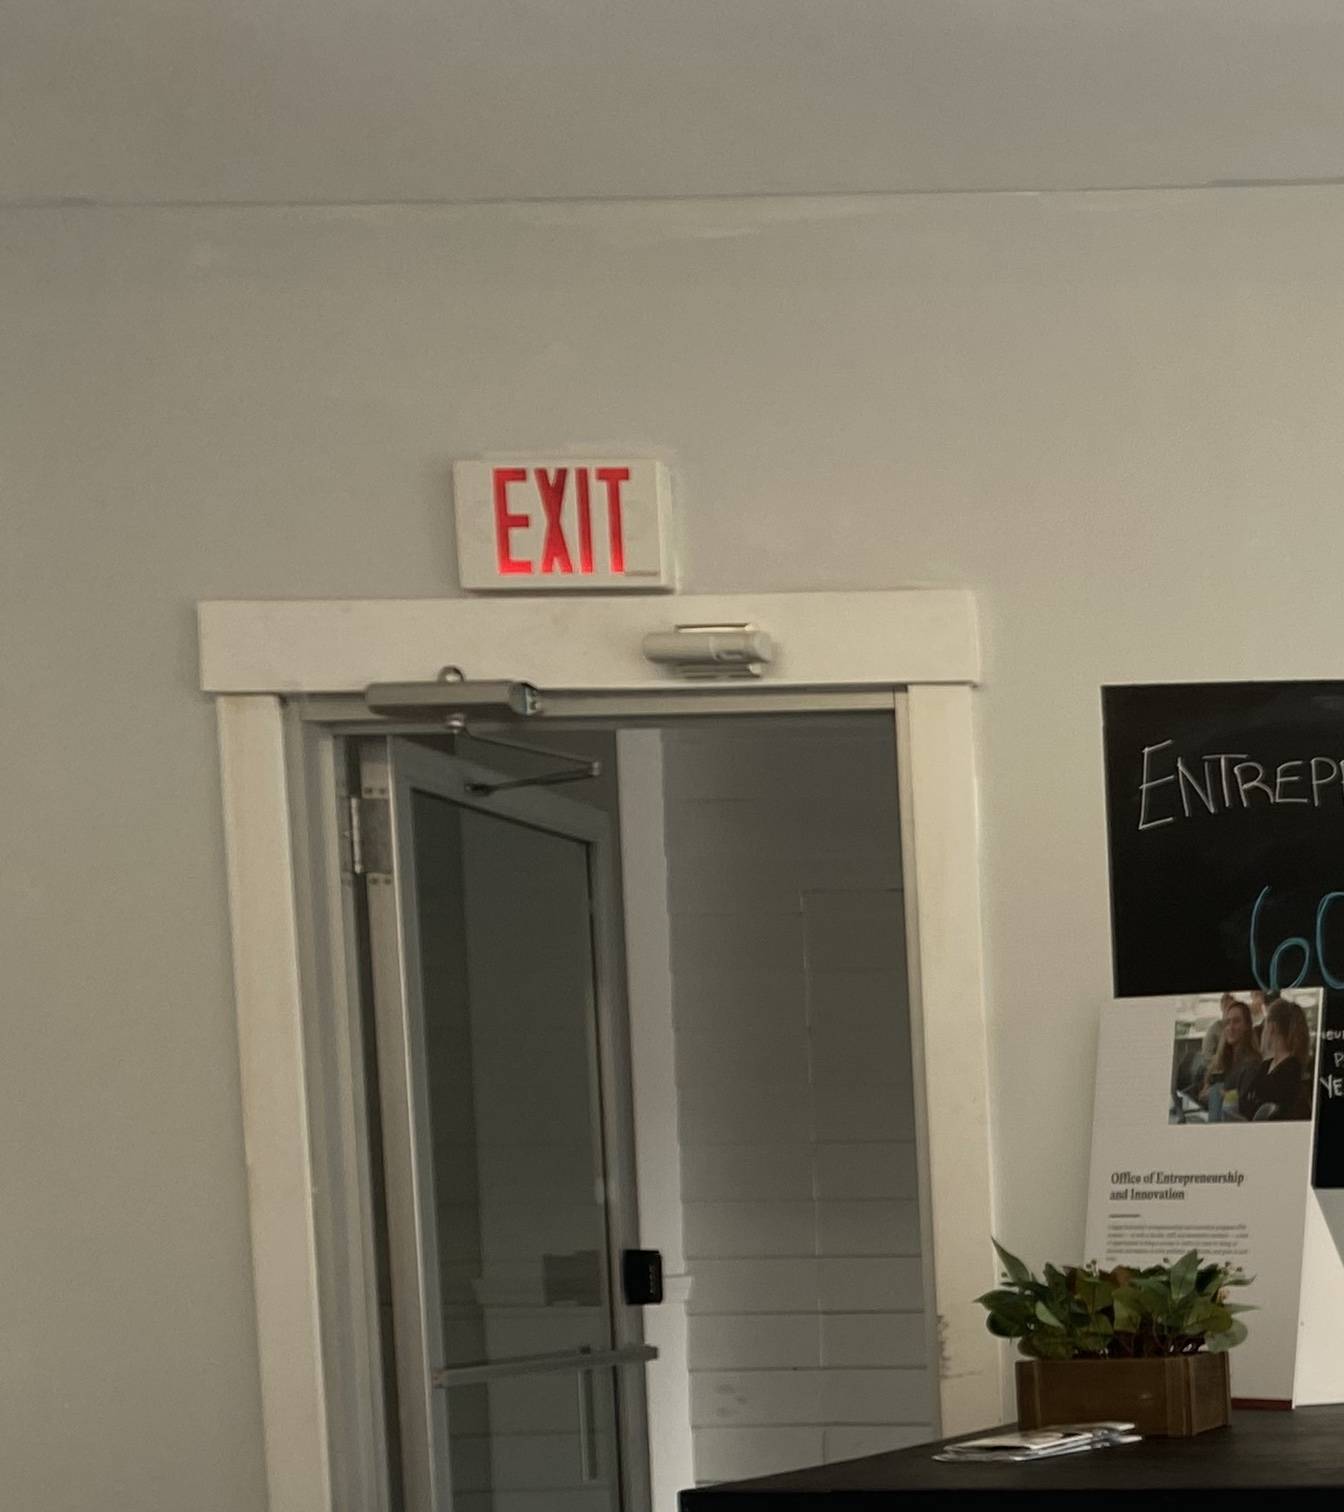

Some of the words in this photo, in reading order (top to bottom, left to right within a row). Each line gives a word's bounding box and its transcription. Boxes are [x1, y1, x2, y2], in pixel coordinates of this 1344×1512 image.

[492, 466, 630, 575] EXIT
[1110, 1171, 1142, 1185] Office
[1143, 1171, 1156, 1184] of
[1156, 1170, 1245, 1187] Entrepreneurship
[1109, 1188, 1128, 1200] and
[1130, 1188, 1185, 1200] Innovation
